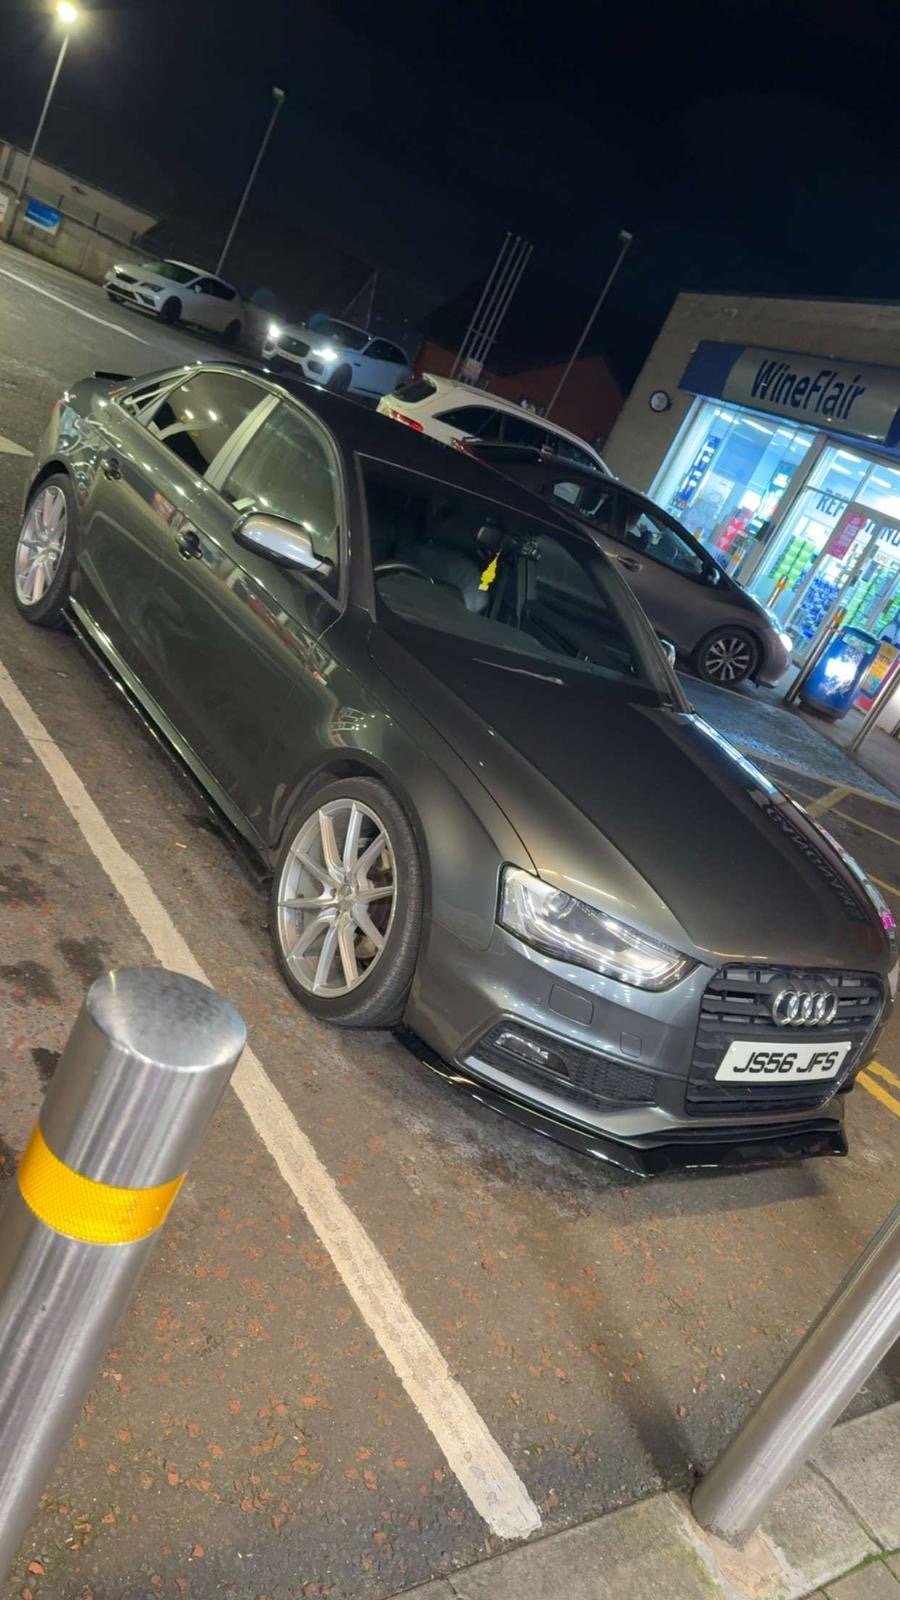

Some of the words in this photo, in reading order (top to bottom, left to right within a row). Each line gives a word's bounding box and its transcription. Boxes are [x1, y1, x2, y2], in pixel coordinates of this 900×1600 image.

[751, 360, 866, 420] WineFlair
[733, 1052, 798, 1074] JS56
[797, 1051, 839, 1073] JFS
